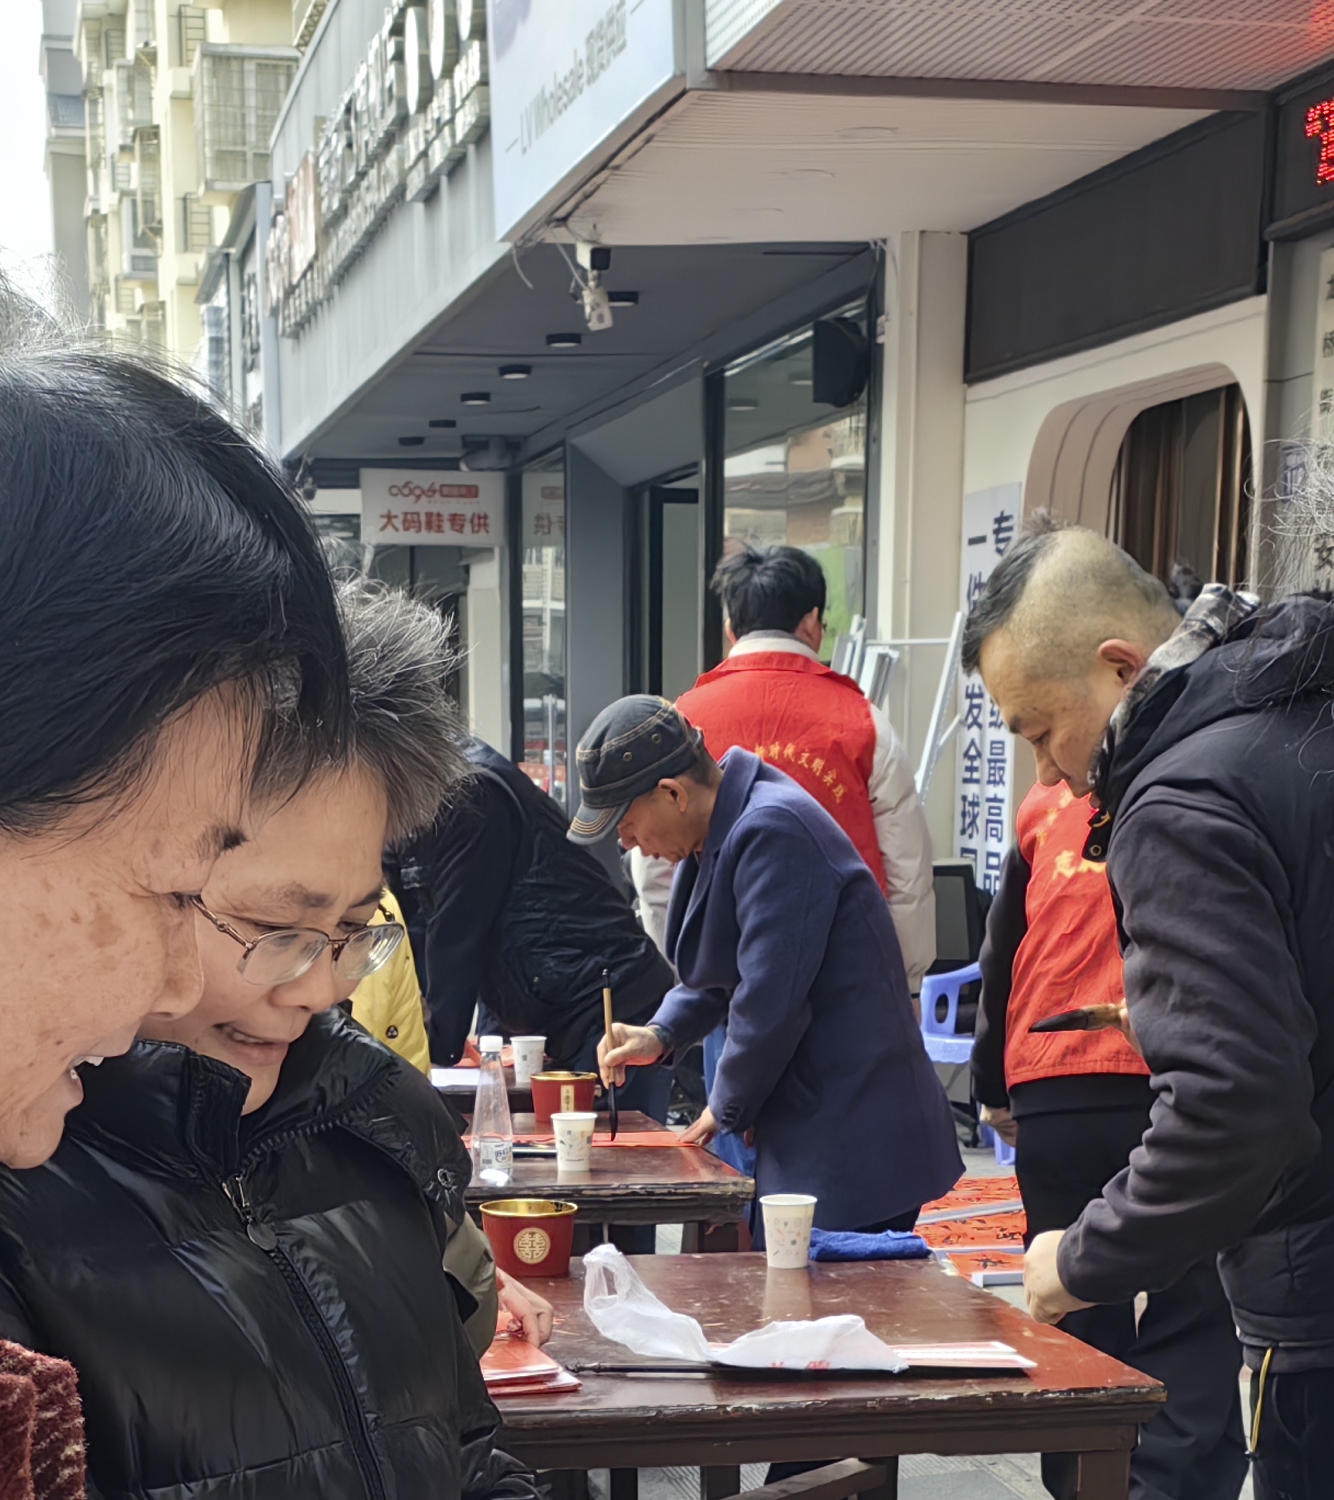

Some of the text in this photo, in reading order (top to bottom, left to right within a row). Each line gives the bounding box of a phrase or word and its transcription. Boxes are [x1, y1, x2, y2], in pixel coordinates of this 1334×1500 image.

[379, 509, 491, 534] 大码鞋专供
